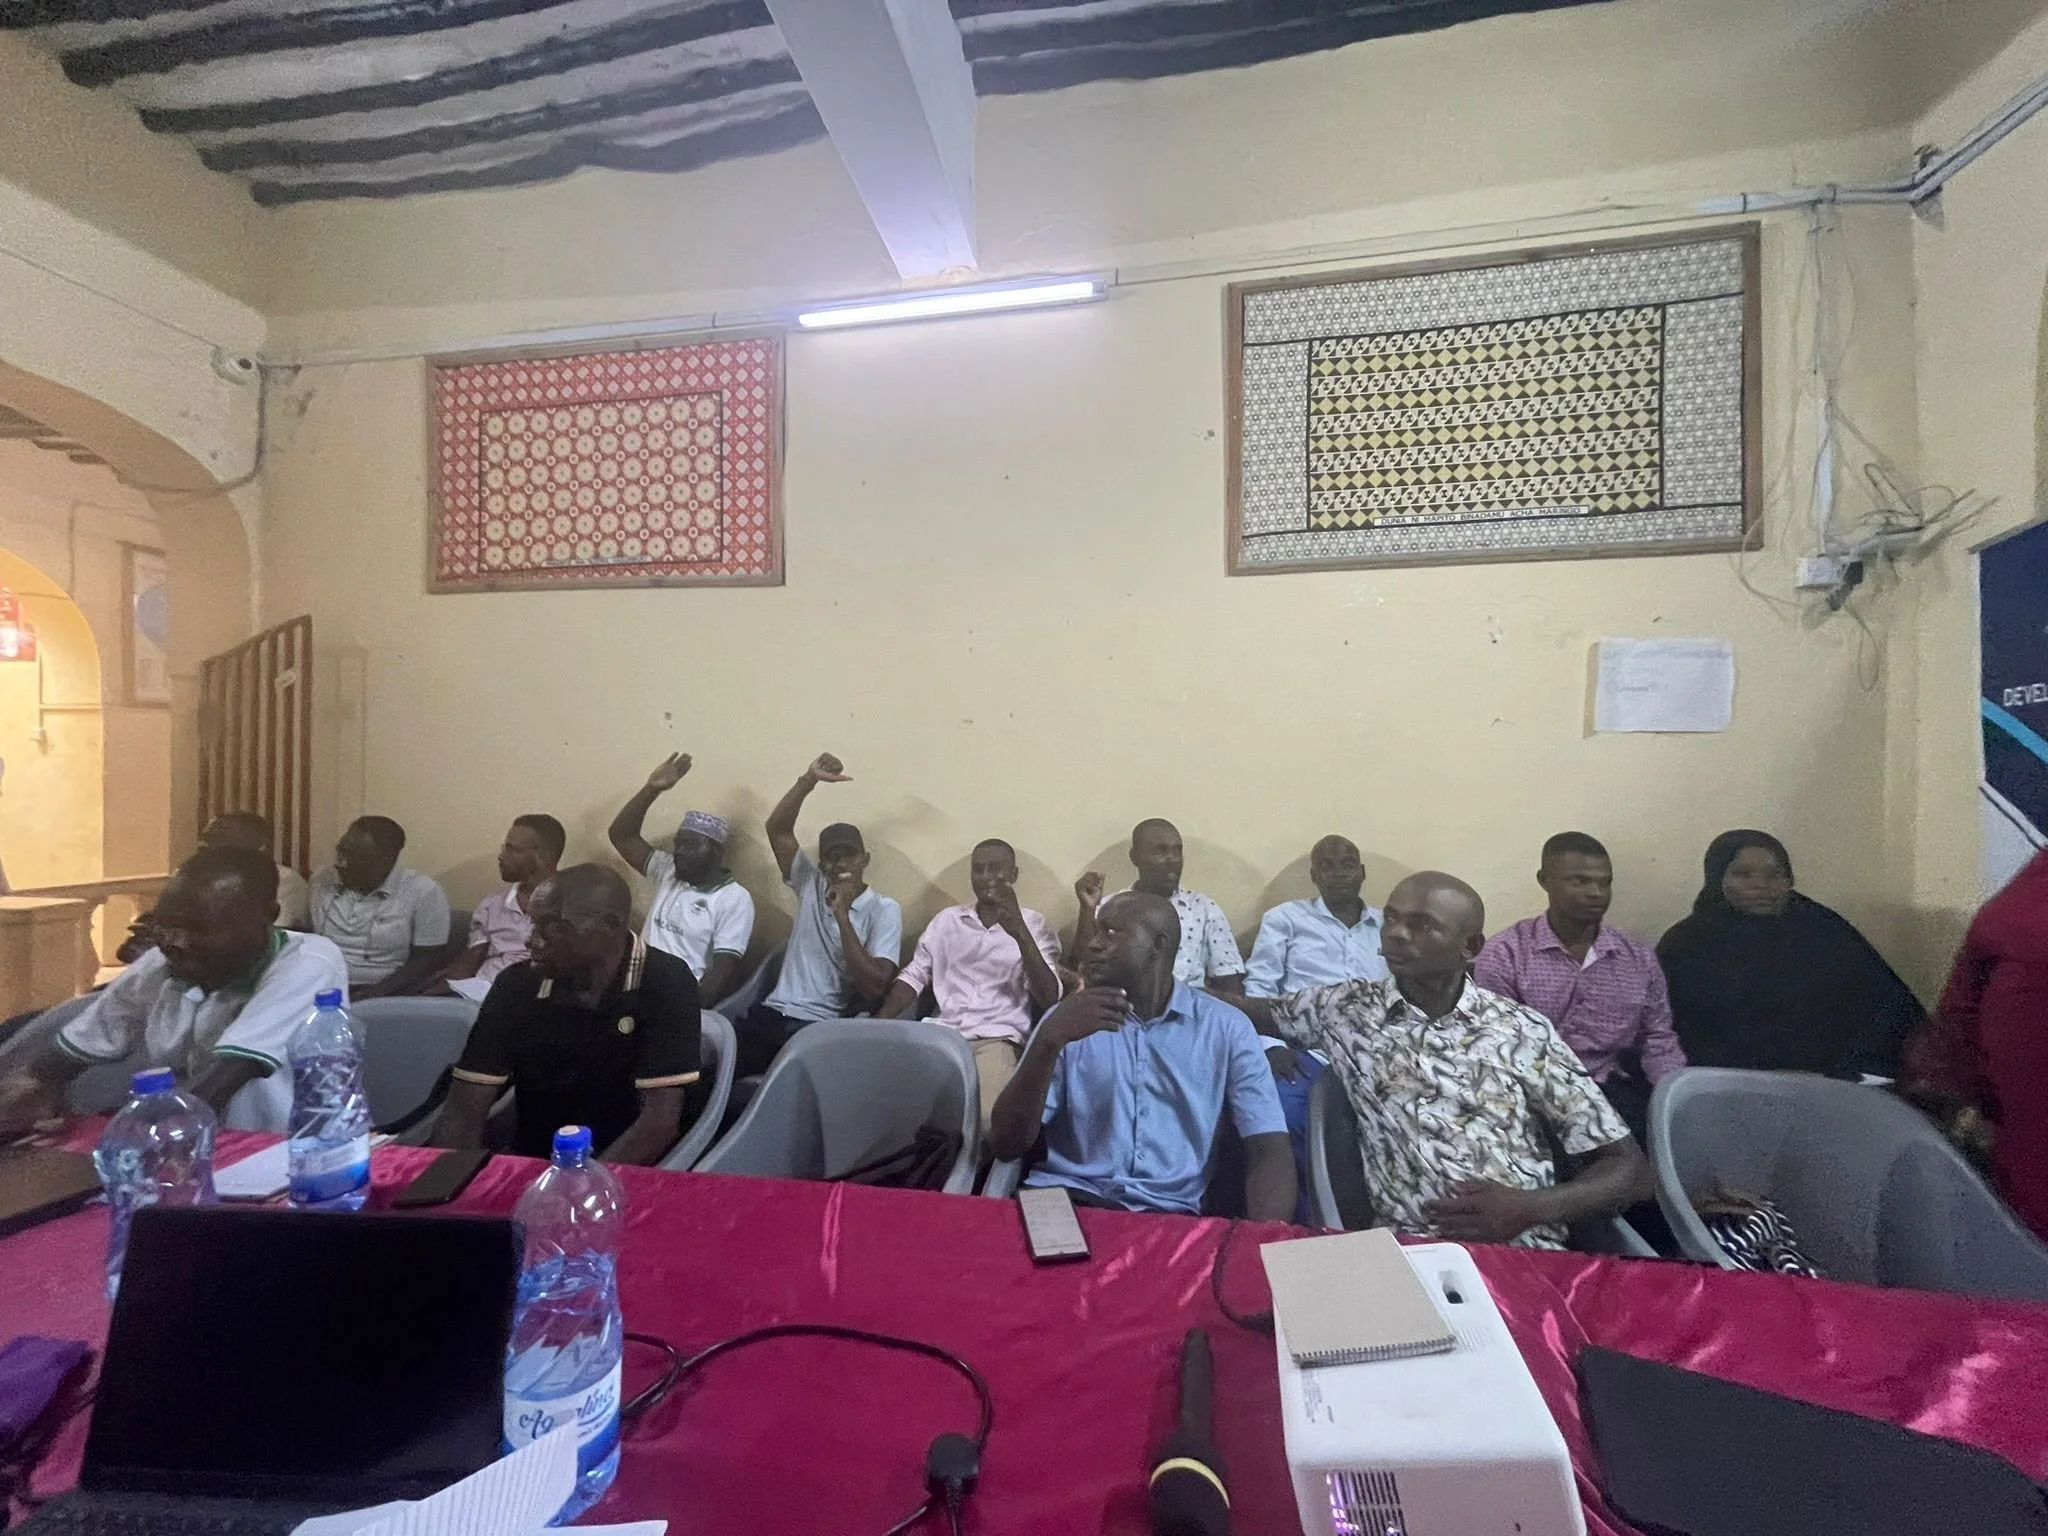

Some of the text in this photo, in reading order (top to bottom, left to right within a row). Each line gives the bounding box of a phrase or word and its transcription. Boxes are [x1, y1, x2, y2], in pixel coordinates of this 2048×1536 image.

[1381, 506, 1581, 525] DUNIA NI MAPITO BINADAMU ACHA MARINGO
